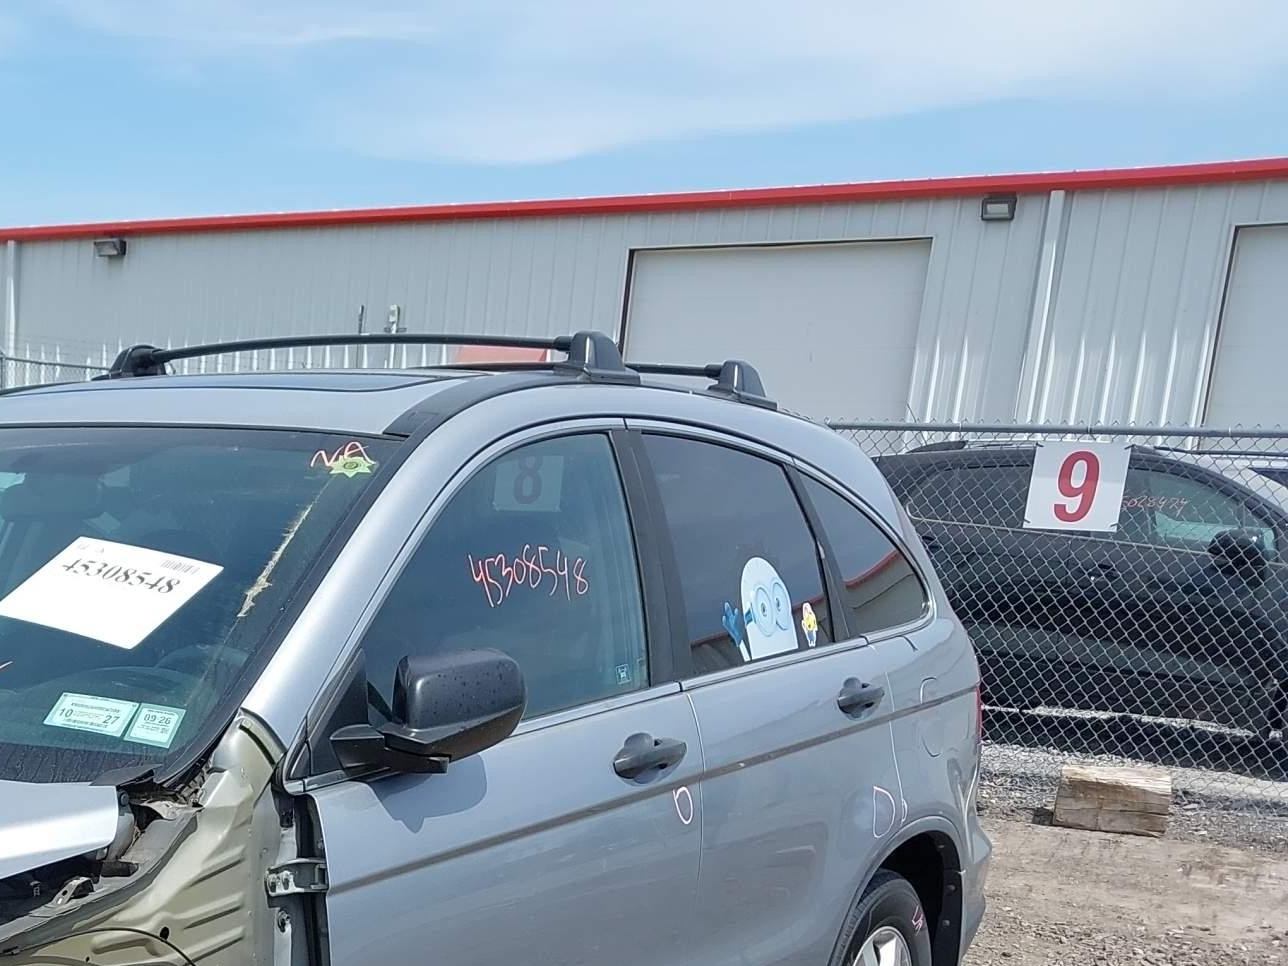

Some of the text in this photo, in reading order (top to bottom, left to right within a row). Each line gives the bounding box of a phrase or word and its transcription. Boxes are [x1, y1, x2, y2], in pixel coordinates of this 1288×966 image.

[1052, 449, 1101, 523] 9
[62, 558, 181, 594] 45308548
[467, 544, 589, 608] 45308548
[58, 707, 74, 718] 10
[101, 713, 121, 725] 27
[158, 716, 172, 725] 26
